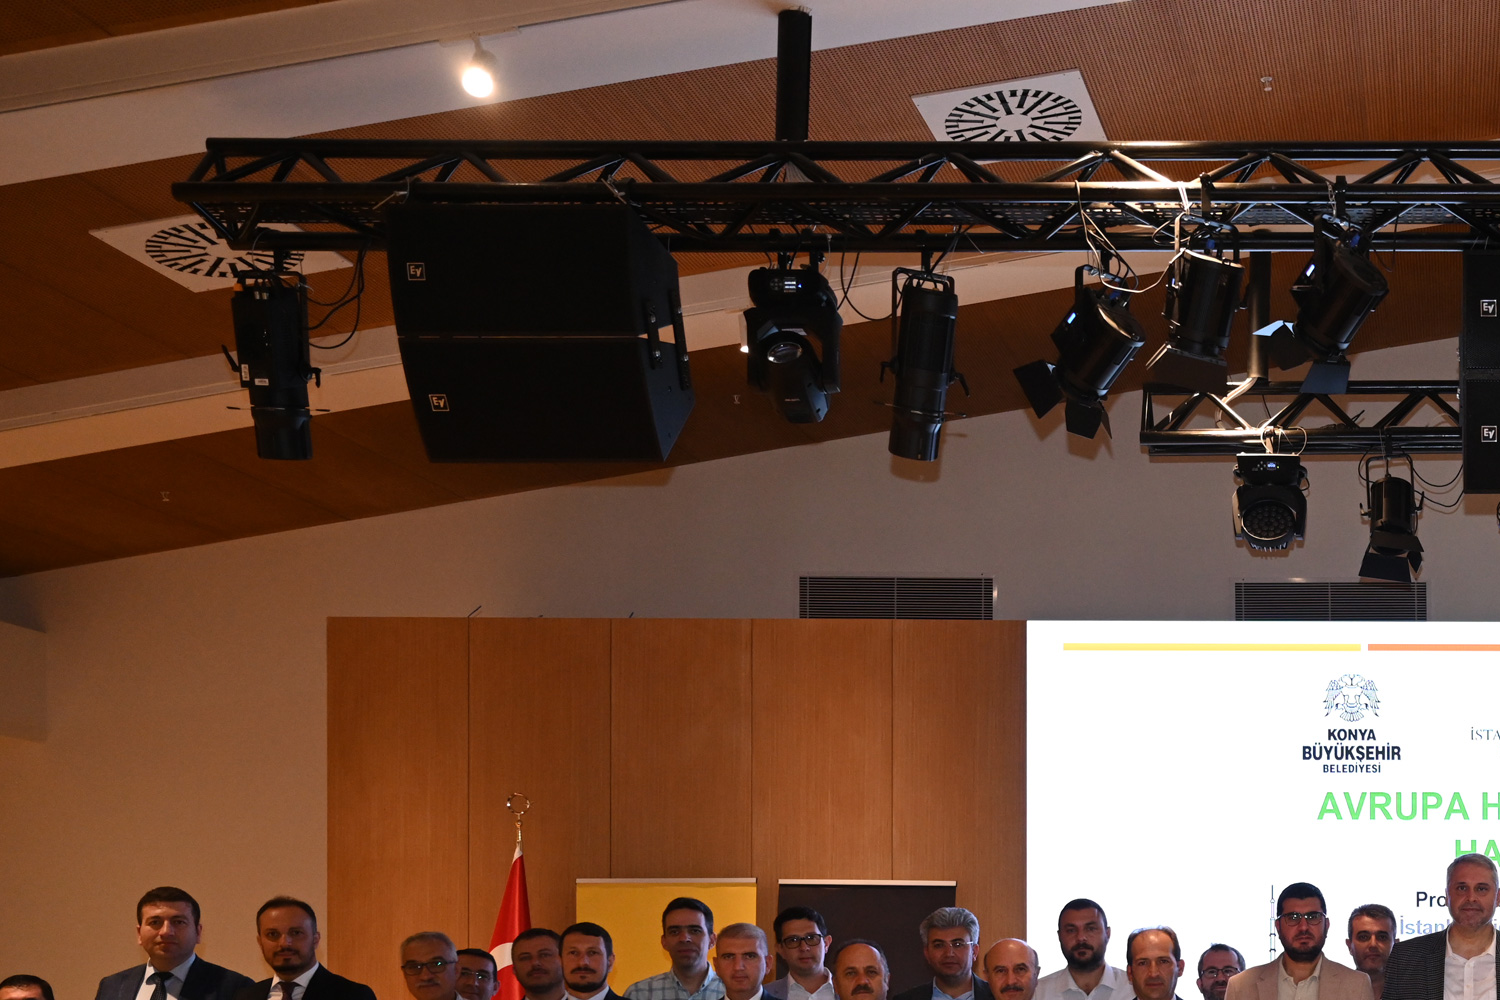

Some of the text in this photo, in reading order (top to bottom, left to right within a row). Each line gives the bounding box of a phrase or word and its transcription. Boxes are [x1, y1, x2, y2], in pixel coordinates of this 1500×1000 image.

[1327, 728, 1377, 742] KONYA
[1302, 742, 1402, 762] BÜYÜKŞEHİR
[1322, 762, 1382, 774] BELEDİYESİ
[1317, 791, 1470, 821] AVRUPA
